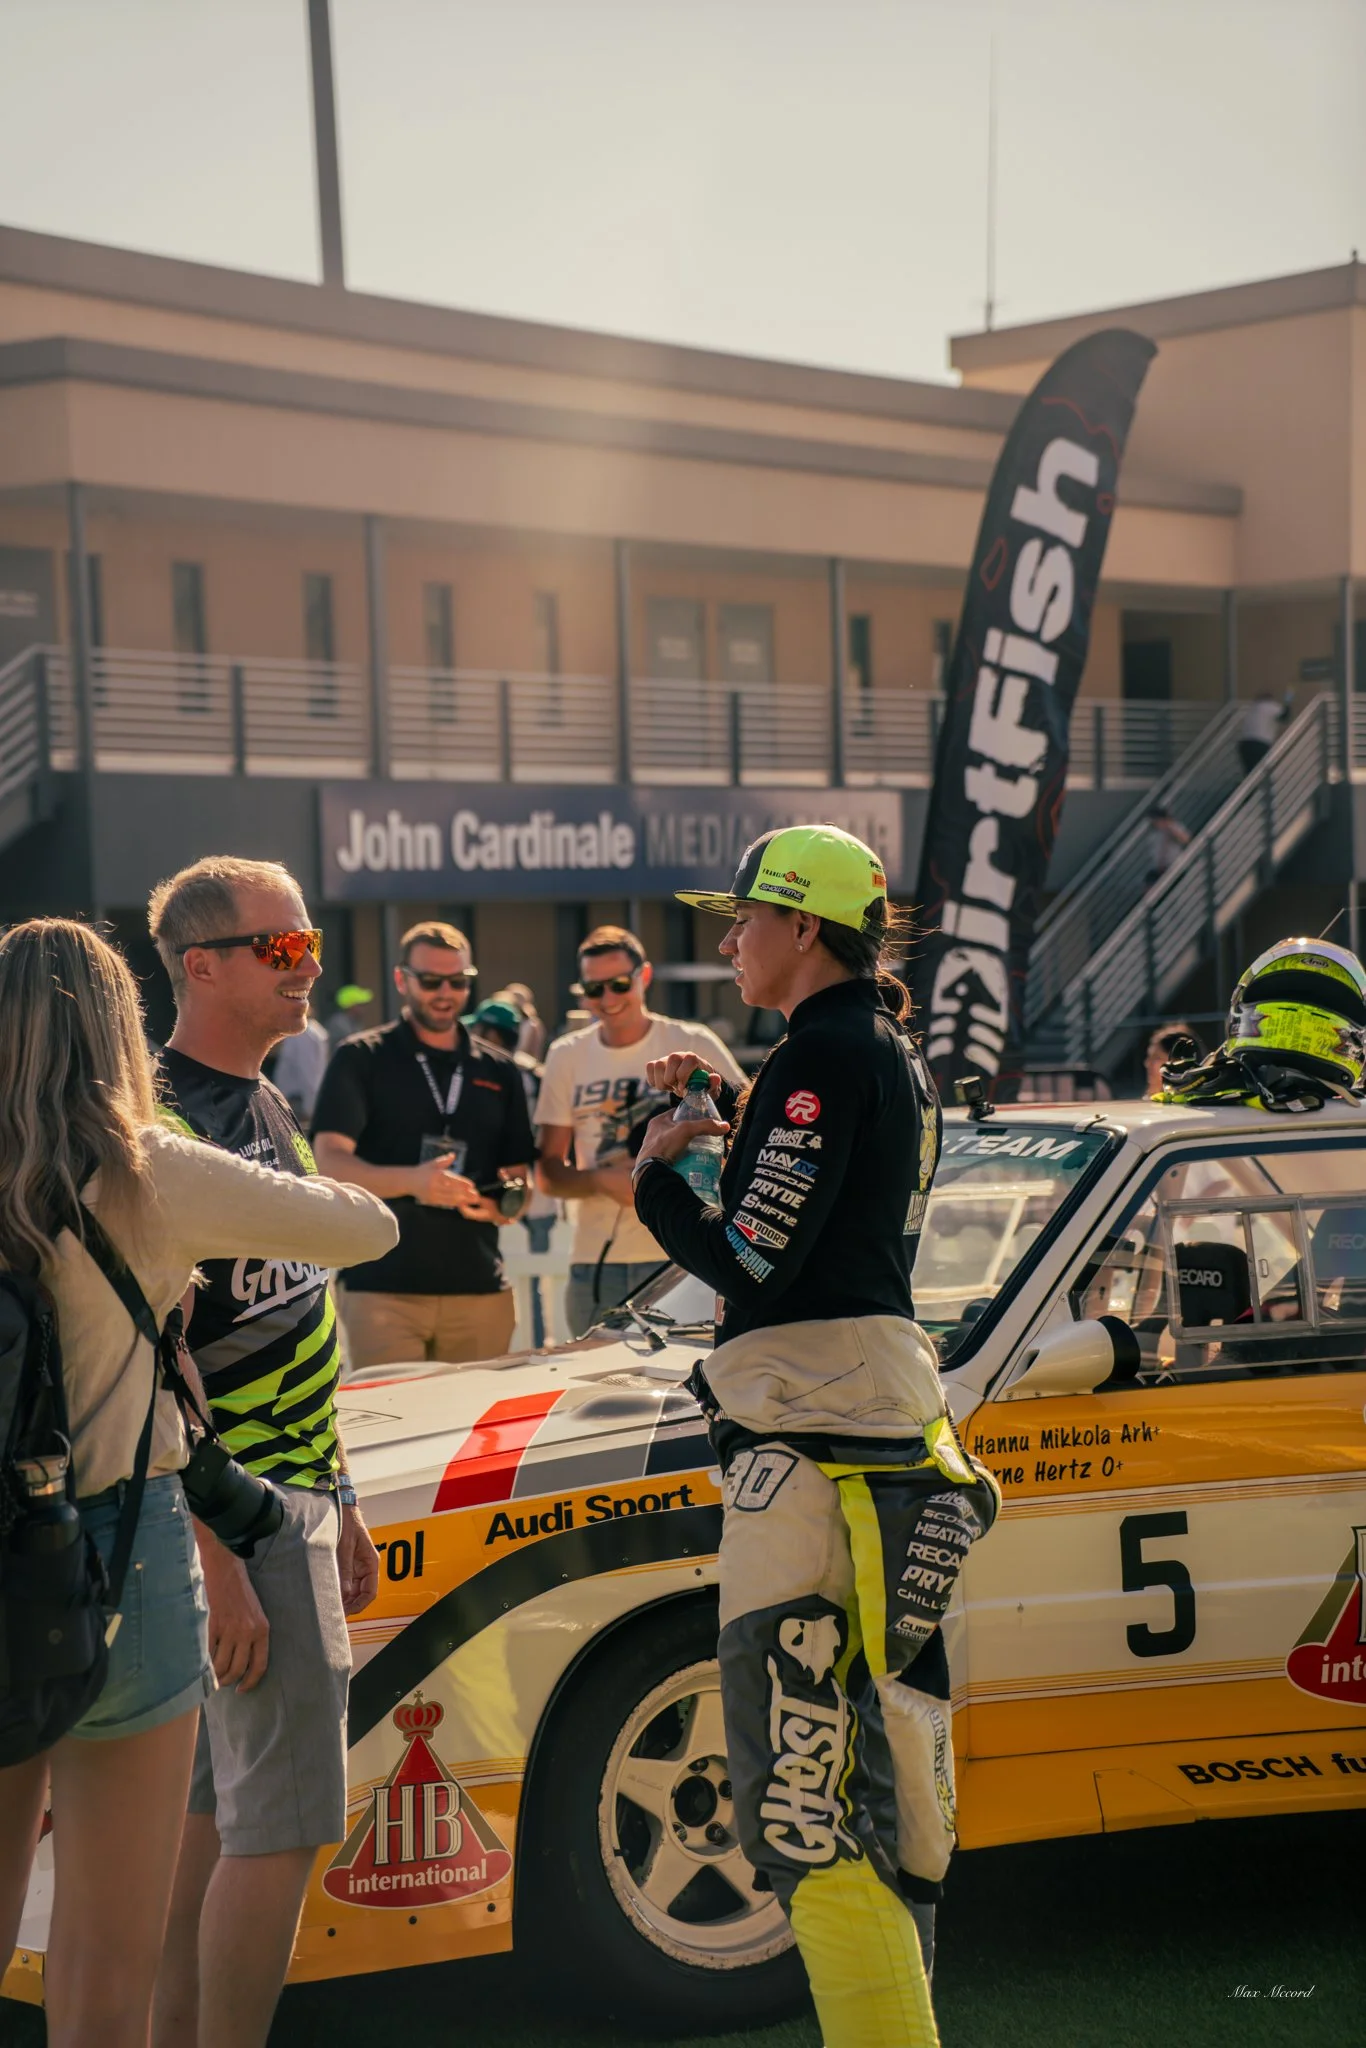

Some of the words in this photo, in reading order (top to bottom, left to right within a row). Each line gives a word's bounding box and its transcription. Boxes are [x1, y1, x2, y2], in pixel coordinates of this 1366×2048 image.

[337, 809, 442, 872] John
[452, 809, 635, 870] Cardinale
[574, 1078, 665, 1107] 198
[765, 1127, 814, 1149] GHOST
[946, 1134, 1084, 1160] TEAM
[748, 1178, 807, 1209] PRYDE
[735, 1212, 754, 1228] USA
[755, 1223, 787, 1247] DOORS
[1328, 1232, 1366, 1250] REC
[1179, 1268, 1223, 1288] ECARO
[974, 1435, 1029, 1455] Hannu
[1041, 1425, 1111, 1449] Mikkola
[985, 1466, 1024, 1485] rne
[1035, 1459, 1092, 1482] Hertz
[1102, 1456, 1123, 1477] O+
[484, 1500, 573, 1546] Audi
[585, 1484, 696, 1524] Sport
[901, 1565, 956, 1595] PRY
[1120, 1511, 1196, 1658] 5
[760, 1655, 859, 1864] GHOST
[1177, 1755, 1324, 1786] BOSCH
[371, 1779, 464, 1867] HB
[348, 1858, 488, 1894] international
